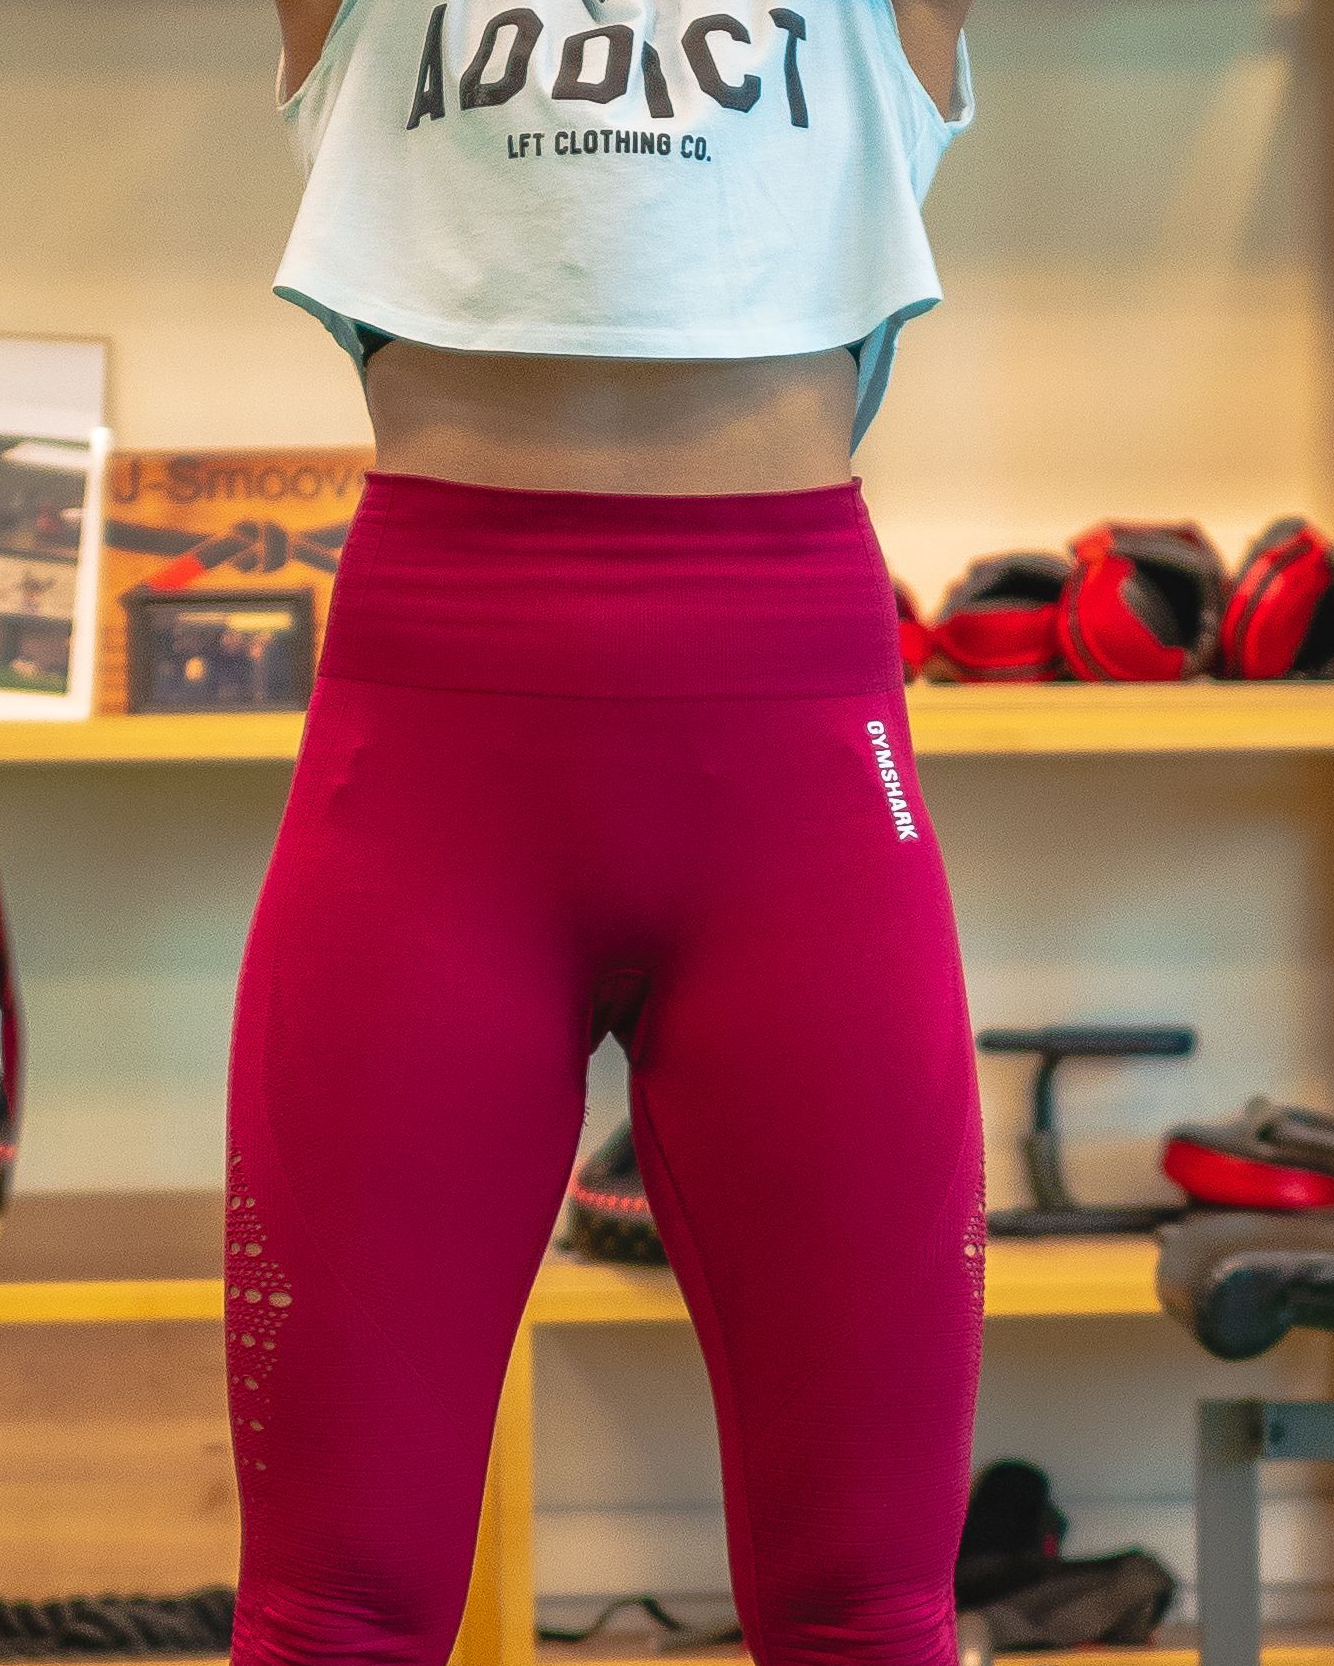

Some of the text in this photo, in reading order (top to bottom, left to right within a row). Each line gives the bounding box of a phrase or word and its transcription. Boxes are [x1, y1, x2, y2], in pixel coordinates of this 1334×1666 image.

[406, 3, 809, 130] ADDICT
[507, 129, 712, 162] LFT CLOTHING CO.
[114, 454, 369, 505] J-Smoov
[867, 719, 919, 841] GYMSHARK
